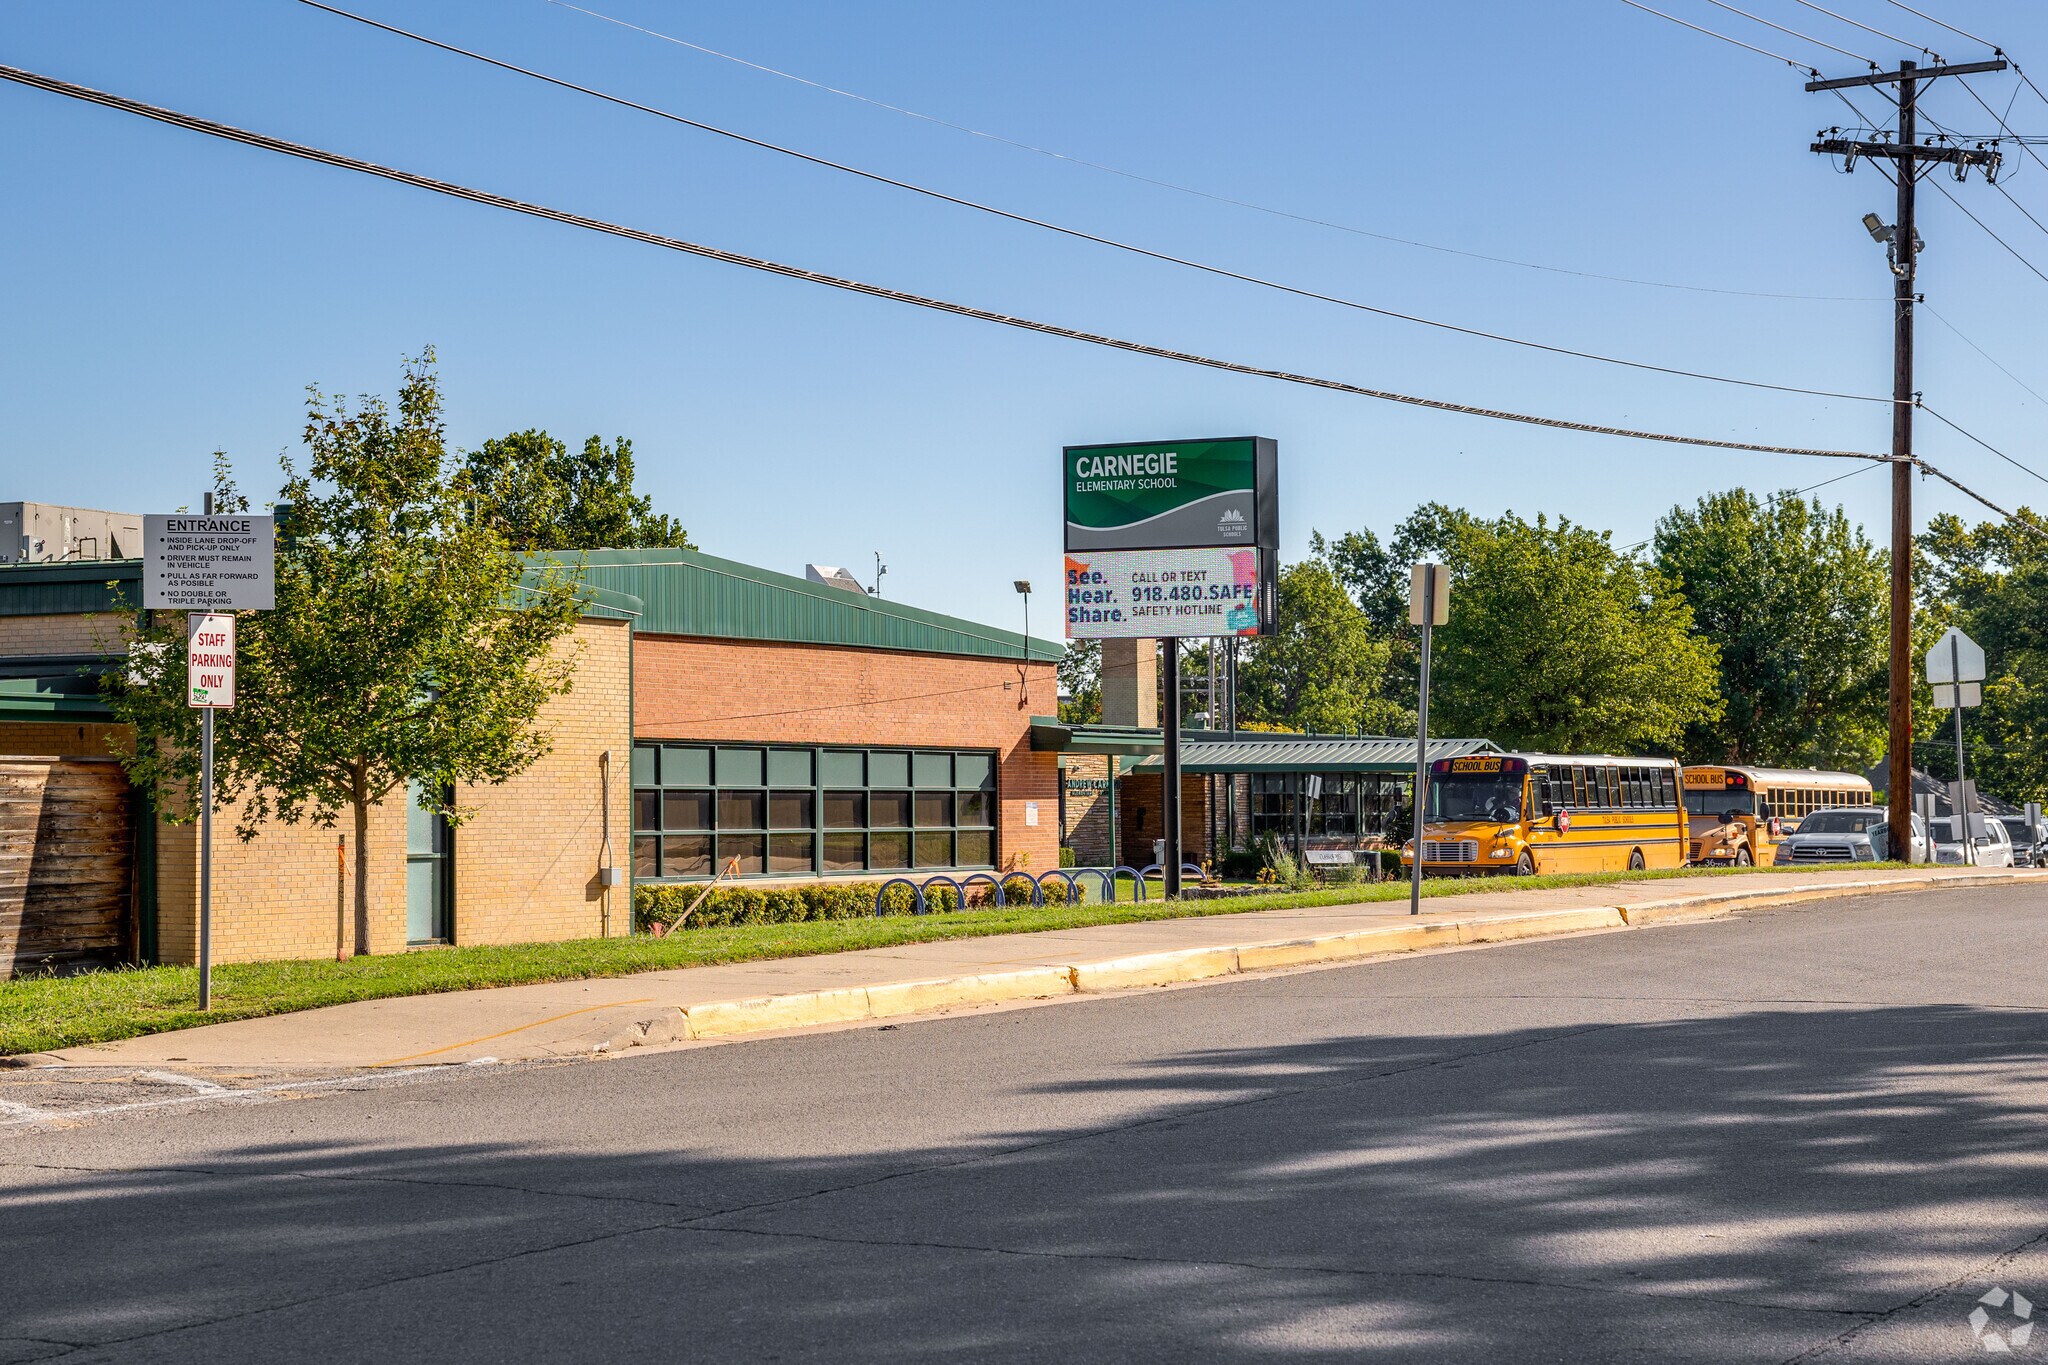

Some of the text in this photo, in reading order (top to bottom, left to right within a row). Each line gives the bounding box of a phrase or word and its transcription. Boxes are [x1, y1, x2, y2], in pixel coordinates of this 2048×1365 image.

[1076, 452, 1178, 478] CARNEGIE
[1076, 478, 1177, 492] ELEMENTARY SCHOOL
[167, 519, 250, 532] ENTRANCE
[1068, 570, 1107, 585] See.
[1132, 571, 1207, 583] CALL OR TEXT
[1068, 588, 1117, 604] Hear.
[1132, 585, 1252, 602] 918.480.SAFE
[1068, 607, 1127, 623] Share.
[1133, 605, 1222, 616] SAFETY HOTLINE
[198, 633, 226, 646] STAFF
[192, 654, 232, 667] PARKING
[201, 675, 224, 688] ONLY
[1453, 761, 1501, 772] SCHOOL BUS
[1685, 774, 1723, 784] SCHOOL BUS
